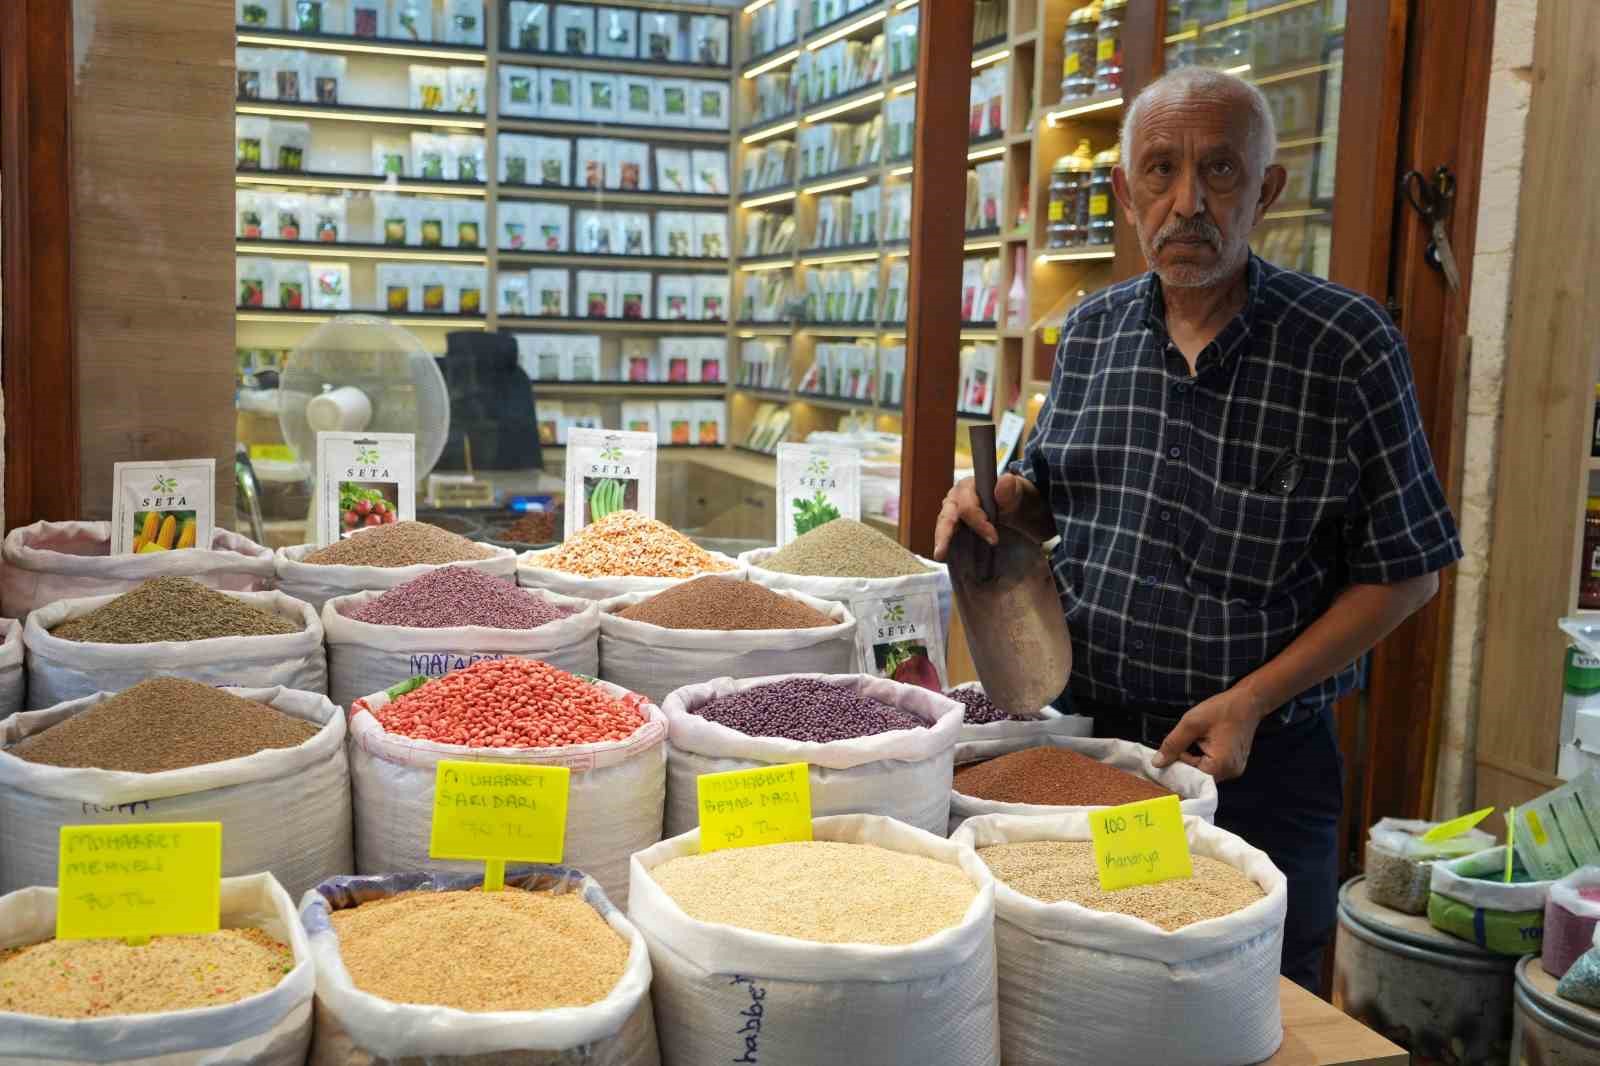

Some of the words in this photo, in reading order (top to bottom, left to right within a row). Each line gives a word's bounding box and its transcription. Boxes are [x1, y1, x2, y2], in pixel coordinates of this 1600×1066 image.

[346, 468, 389, 478] SETA
[591, 464, 631, 475] SETA
[799, 478, 836, 489] SETA
[142, 496, 187, 507] SETA
[877, 623, 916, 638] SETA
[1104, 816, 1127, 835] 100
[1133, 810, 1156, 828] TL
